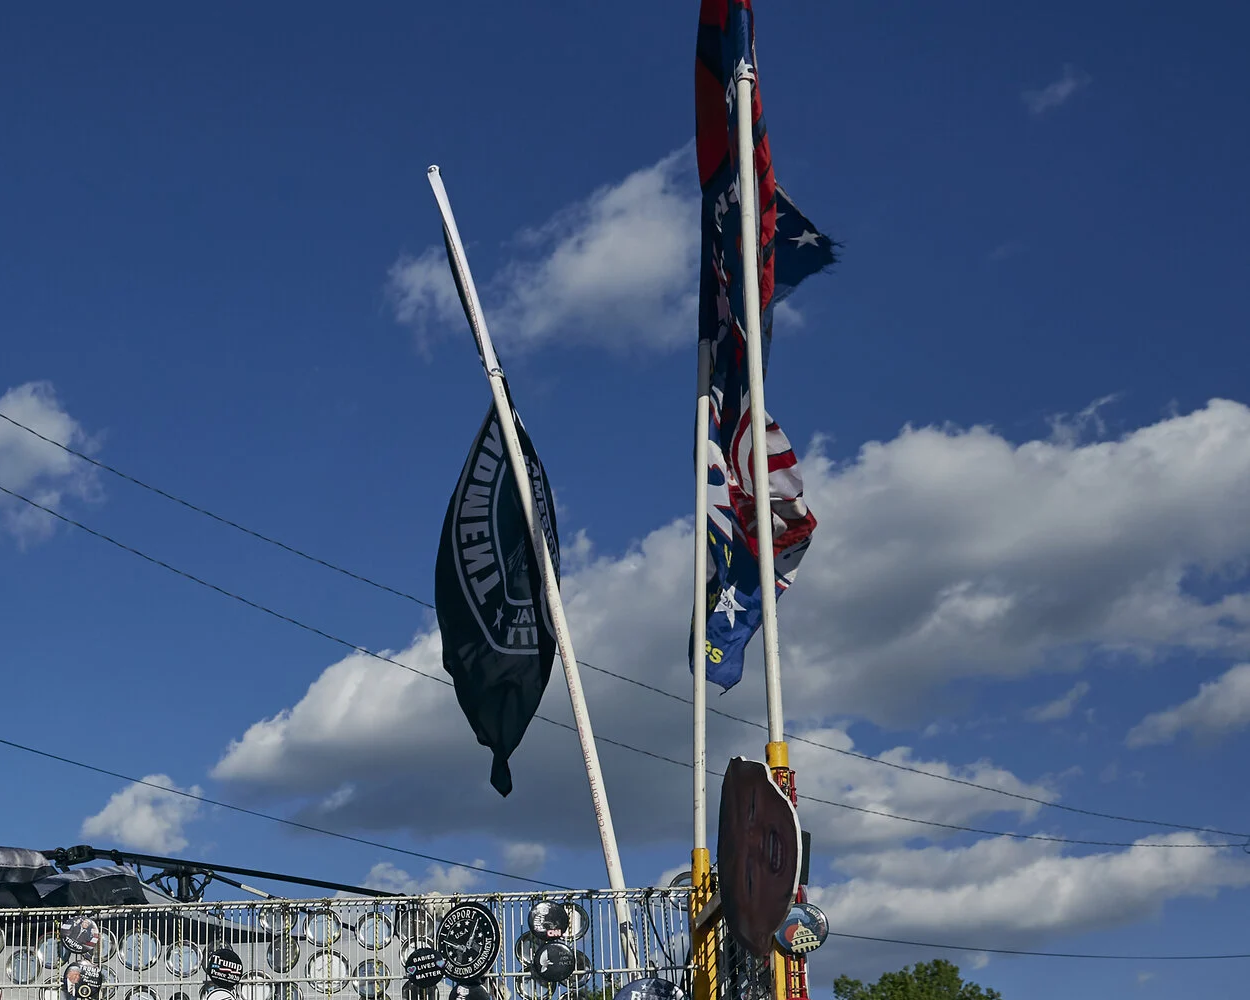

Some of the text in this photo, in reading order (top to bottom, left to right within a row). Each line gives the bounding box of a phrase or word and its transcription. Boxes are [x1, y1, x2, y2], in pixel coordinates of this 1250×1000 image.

[444, 909, 476, 930] SUPPORT
[65, 936, 83, 950] TRUMP
[212, 954, 242, 972] Trump
[412, 953, 435, 963] BABIES
[454, 967, 472, 975] SECOND
[473, 937, 492, 970] AMENDMENT
[417, 962, 436, 971] LIVES
[415, 970, 442, 980] MATTER
